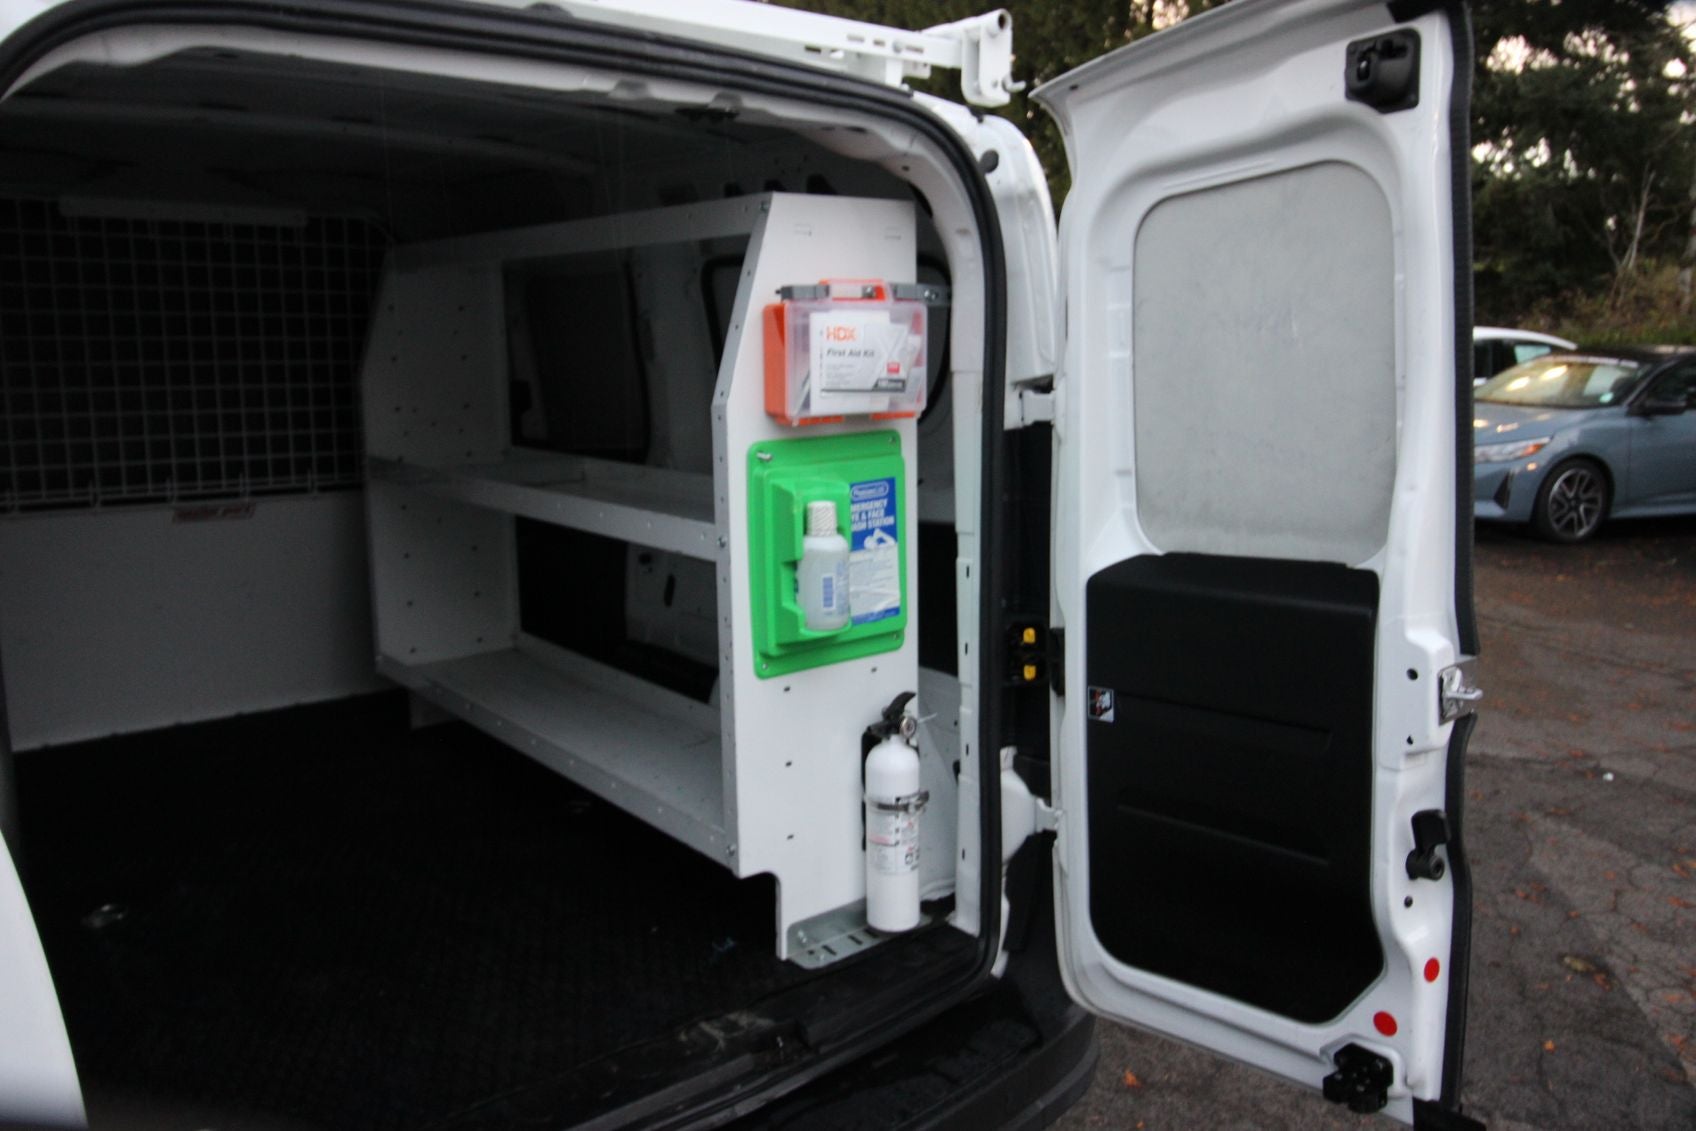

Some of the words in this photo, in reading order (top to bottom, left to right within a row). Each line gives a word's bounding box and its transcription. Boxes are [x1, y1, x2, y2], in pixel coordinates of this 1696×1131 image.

[827, 326, 855, 340] HDX
[827, 347, 845, 356] First
[848, 347, 861, 357] Aid
[863, 347, 874, 356] Kit
[851, 499, 887, 512] MERGENCY
